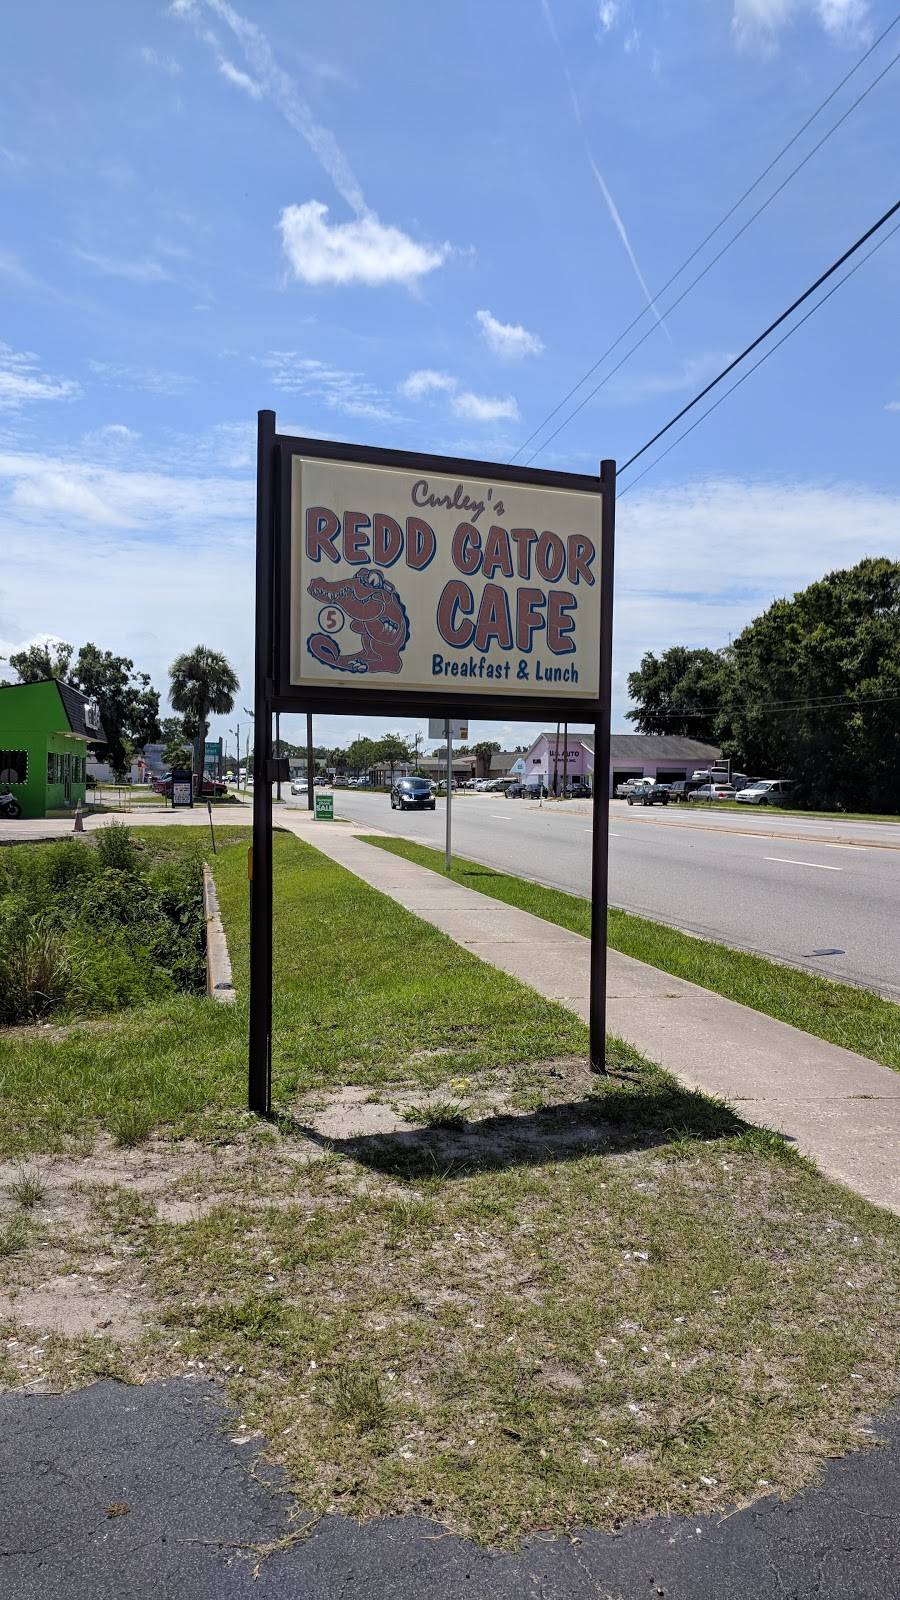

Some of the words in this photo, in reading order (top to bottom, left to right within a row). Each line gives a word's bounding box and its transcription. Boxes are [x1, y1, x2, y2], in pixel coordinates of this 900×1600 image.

[411, 479, 505, 522] Curley's
[305, 507, 436, 571] REDD
[452, 522, 596, 586] GATOR
[326, 610, 337, 629] 5
[437, 579, 578, 655] CAFE
[432, 654, 511, 680] Breakfast
[517, 663, 530, 680] &
[536, 662, 579, 683] Lunch
